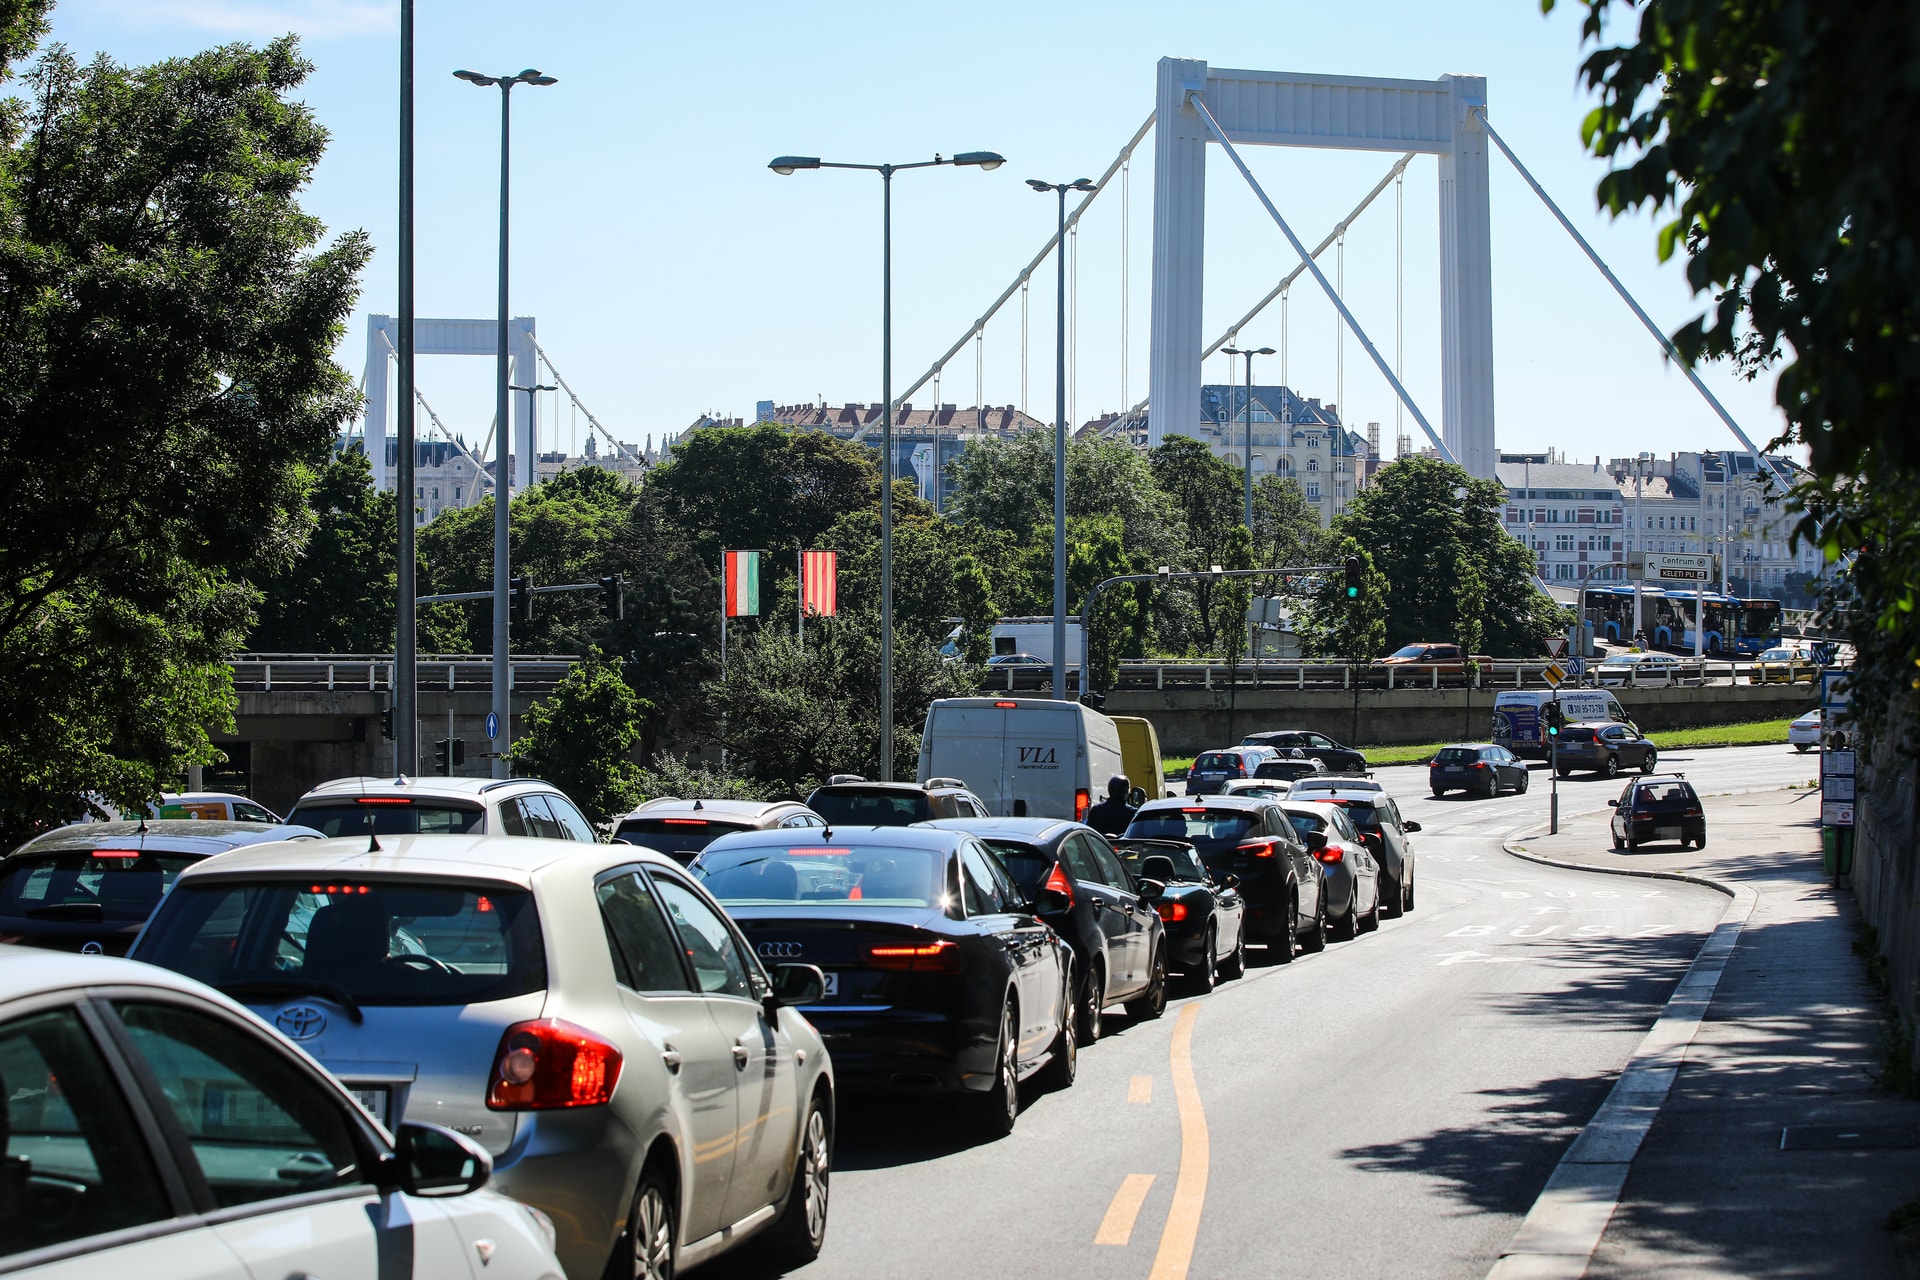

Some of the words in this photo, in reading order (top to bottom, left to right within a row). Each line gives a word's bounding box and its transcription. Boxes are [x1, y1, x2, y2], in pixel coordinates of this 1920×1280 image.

[1662, 556, 1695, 565] Centrum
[1016, 746, 1060, 763] VIA
[1500, 890, 1669, 899] BUSZ
